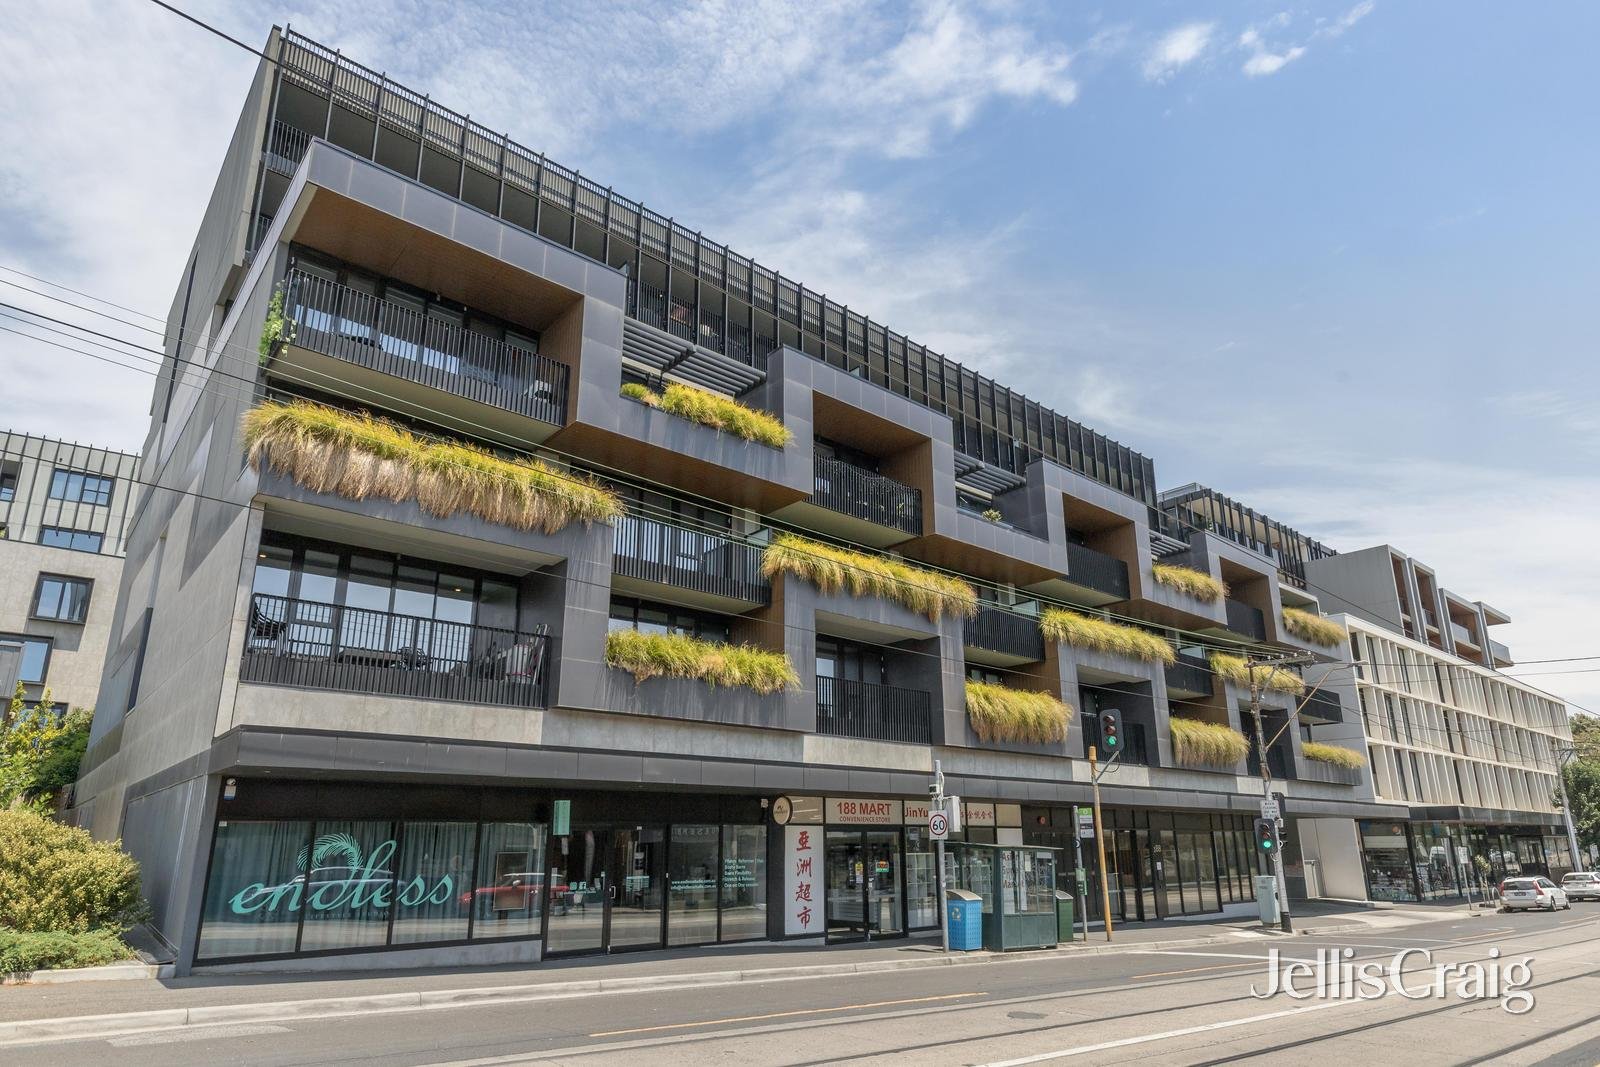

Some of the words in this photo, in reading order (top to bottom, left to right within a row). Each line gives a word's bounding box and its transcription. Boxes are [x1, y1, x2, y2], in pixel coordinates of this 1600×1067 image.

[837, 802, 856, 814] 188
[859, 803, 892, 815] MART
[932, 820, 945, 831] 60
[228, 838, 453, 914] endless
